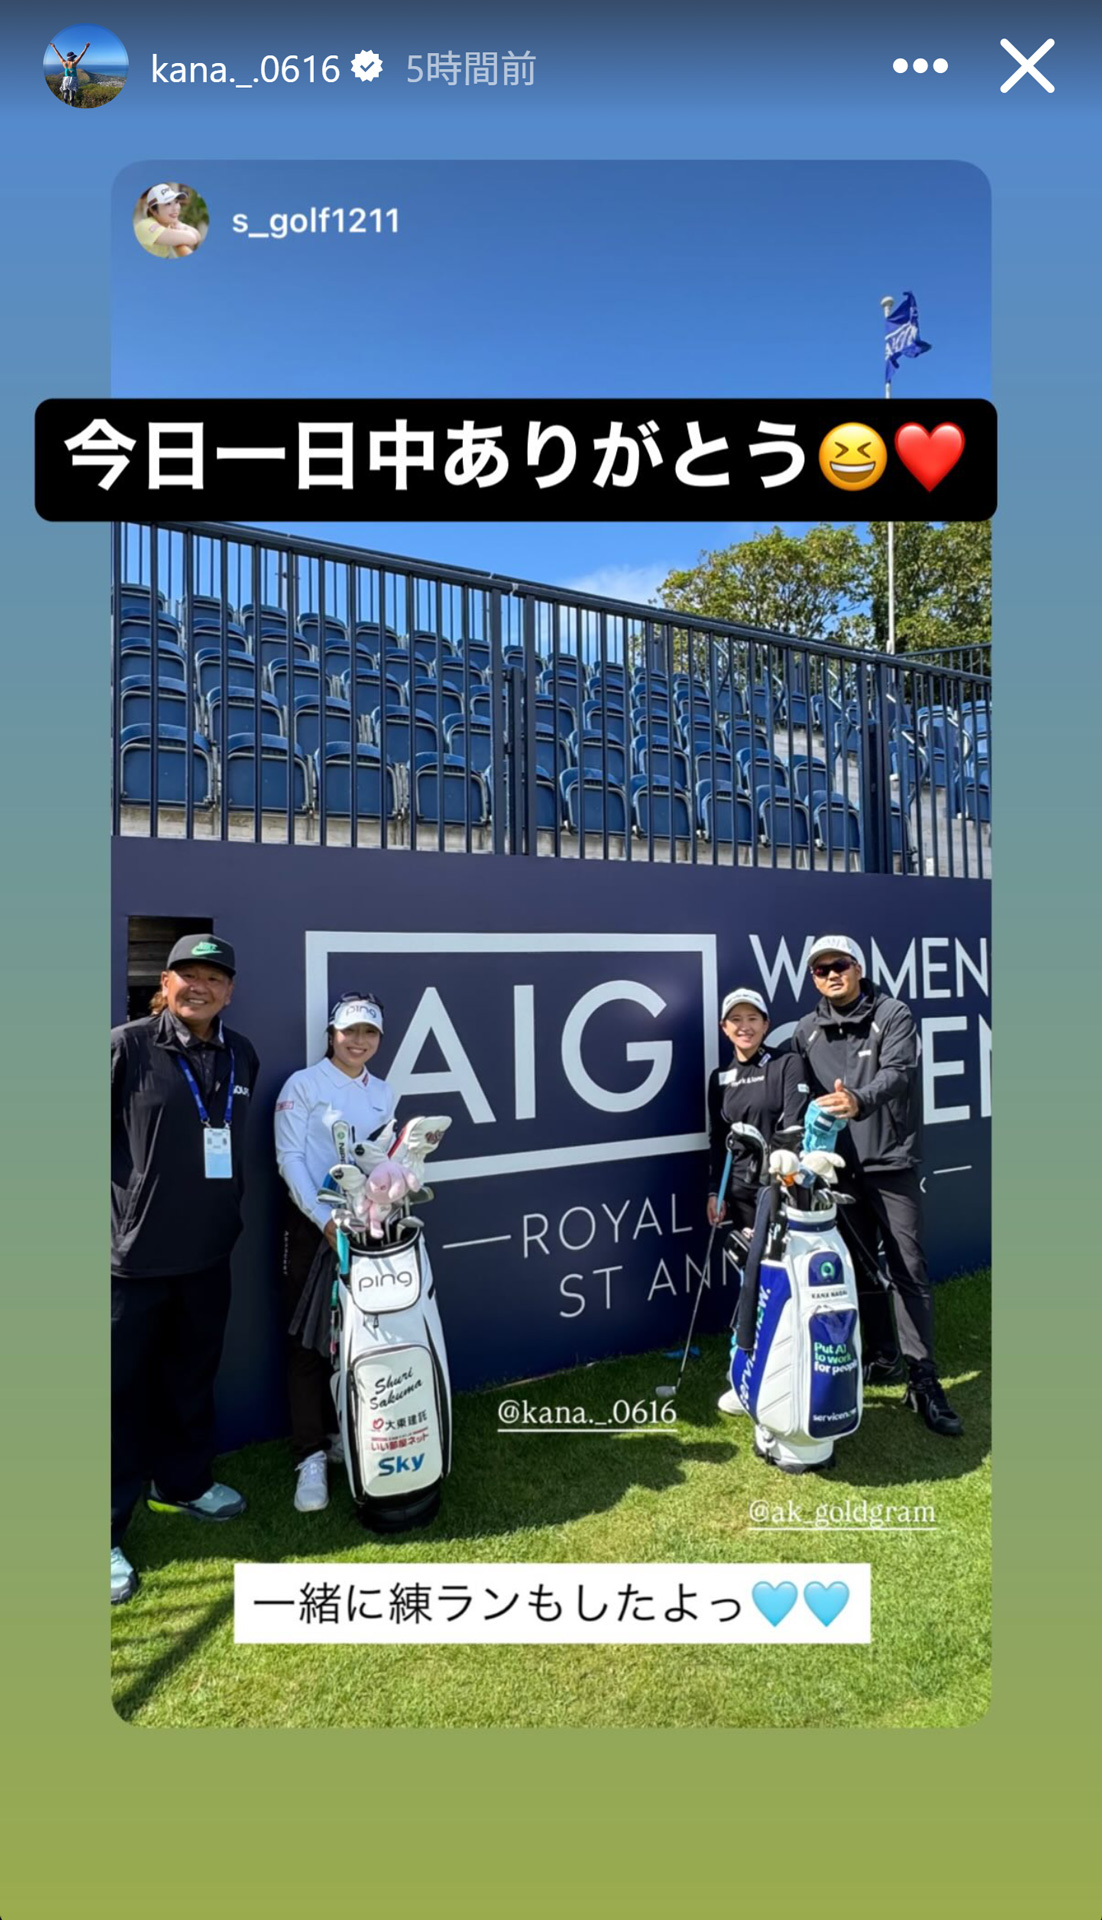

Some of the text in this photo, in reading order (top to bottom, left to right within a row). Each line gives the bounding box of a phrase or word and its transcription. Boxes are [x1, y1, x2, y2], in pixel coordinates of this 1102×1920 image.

[346, 1005, 377, 1019] ping
[385, 979, 673, 1124] AIG
[523, 1193, 693, 1258] ROYAL
[358, 1271, 413, 1292] ping
[560, 1265, 623, 1318] ST
[814, 1342, 834, 1355] Put
[814, 1352, 826, 1362] to
[814, 1361, 831, 1373] for
[374, 1367, 414, 1395] Shuri
[369, 1379, 424, 1410] Sakuma
[385, 1410, 427, 1431] 大東建託
[378, 1453, 425, 1477] Sky
